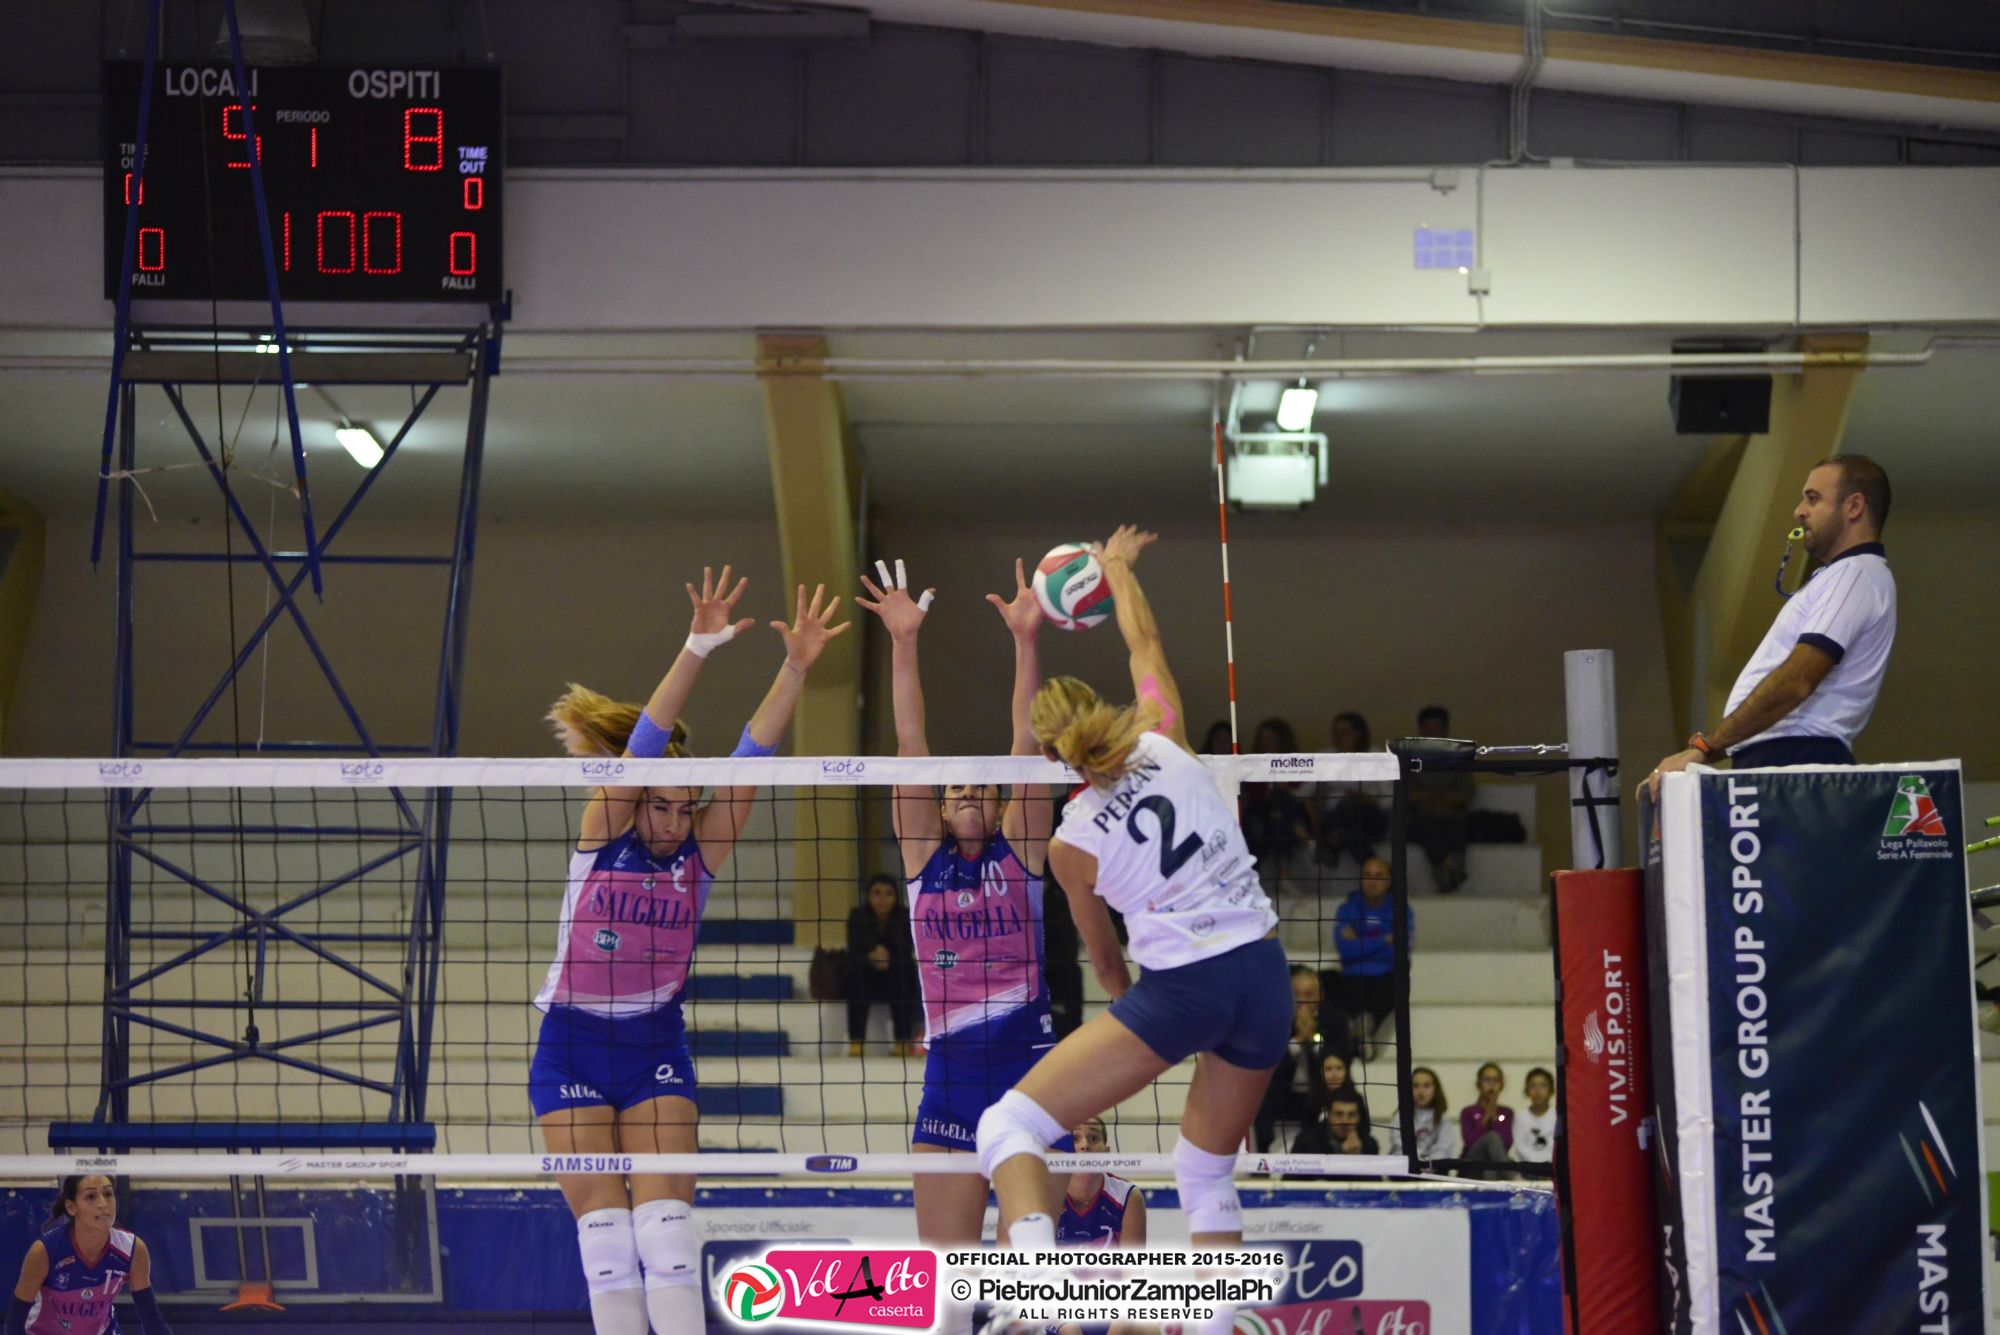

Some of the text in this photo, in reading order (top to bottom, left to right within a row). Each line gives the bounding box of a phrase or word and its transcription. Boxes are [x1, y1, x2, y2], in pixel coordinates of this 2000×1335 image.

[166, 68, 258, 97] LOCAI
[348, 69, 440, 99] OSPITI
[276, 110, 331, 123] PERIODO
[404, 107, 443, 171] 8
[458, 146, 488, 159] TIME
[459, 161, 486, 173] OUT
[464, 177, 482, 210] 0
[139, 228, 164, 270] 0
[450, 231, 476, 274] 0
[132, 274, 165, 286] FALLI
[442, 277, 476, 289] FALLI
[1271, 757, 1314, 768] molten
[1126, 794, 1205, 880] 2
[1880, 838, 1949, 850] Lega Pallavolo
[1877, 850, 1953, 859] Serie A Femminile
[981, 859, 1008, 897] 10
[1728, 778, 1777, 1262] MASTER GROUP SPORT
[1603, 948, 1628, 1126] VIVISPORT
[306, 1160, 407, 1169] MASTER GROUP SPORT
[541, 1157, 632, 1171] SAMSUNG
[829, 1158, 852, 1170] TIM
[1079, 1159, 1111, 1168] GROUP
[1113, 1159, 1142, 1168] SPORT
